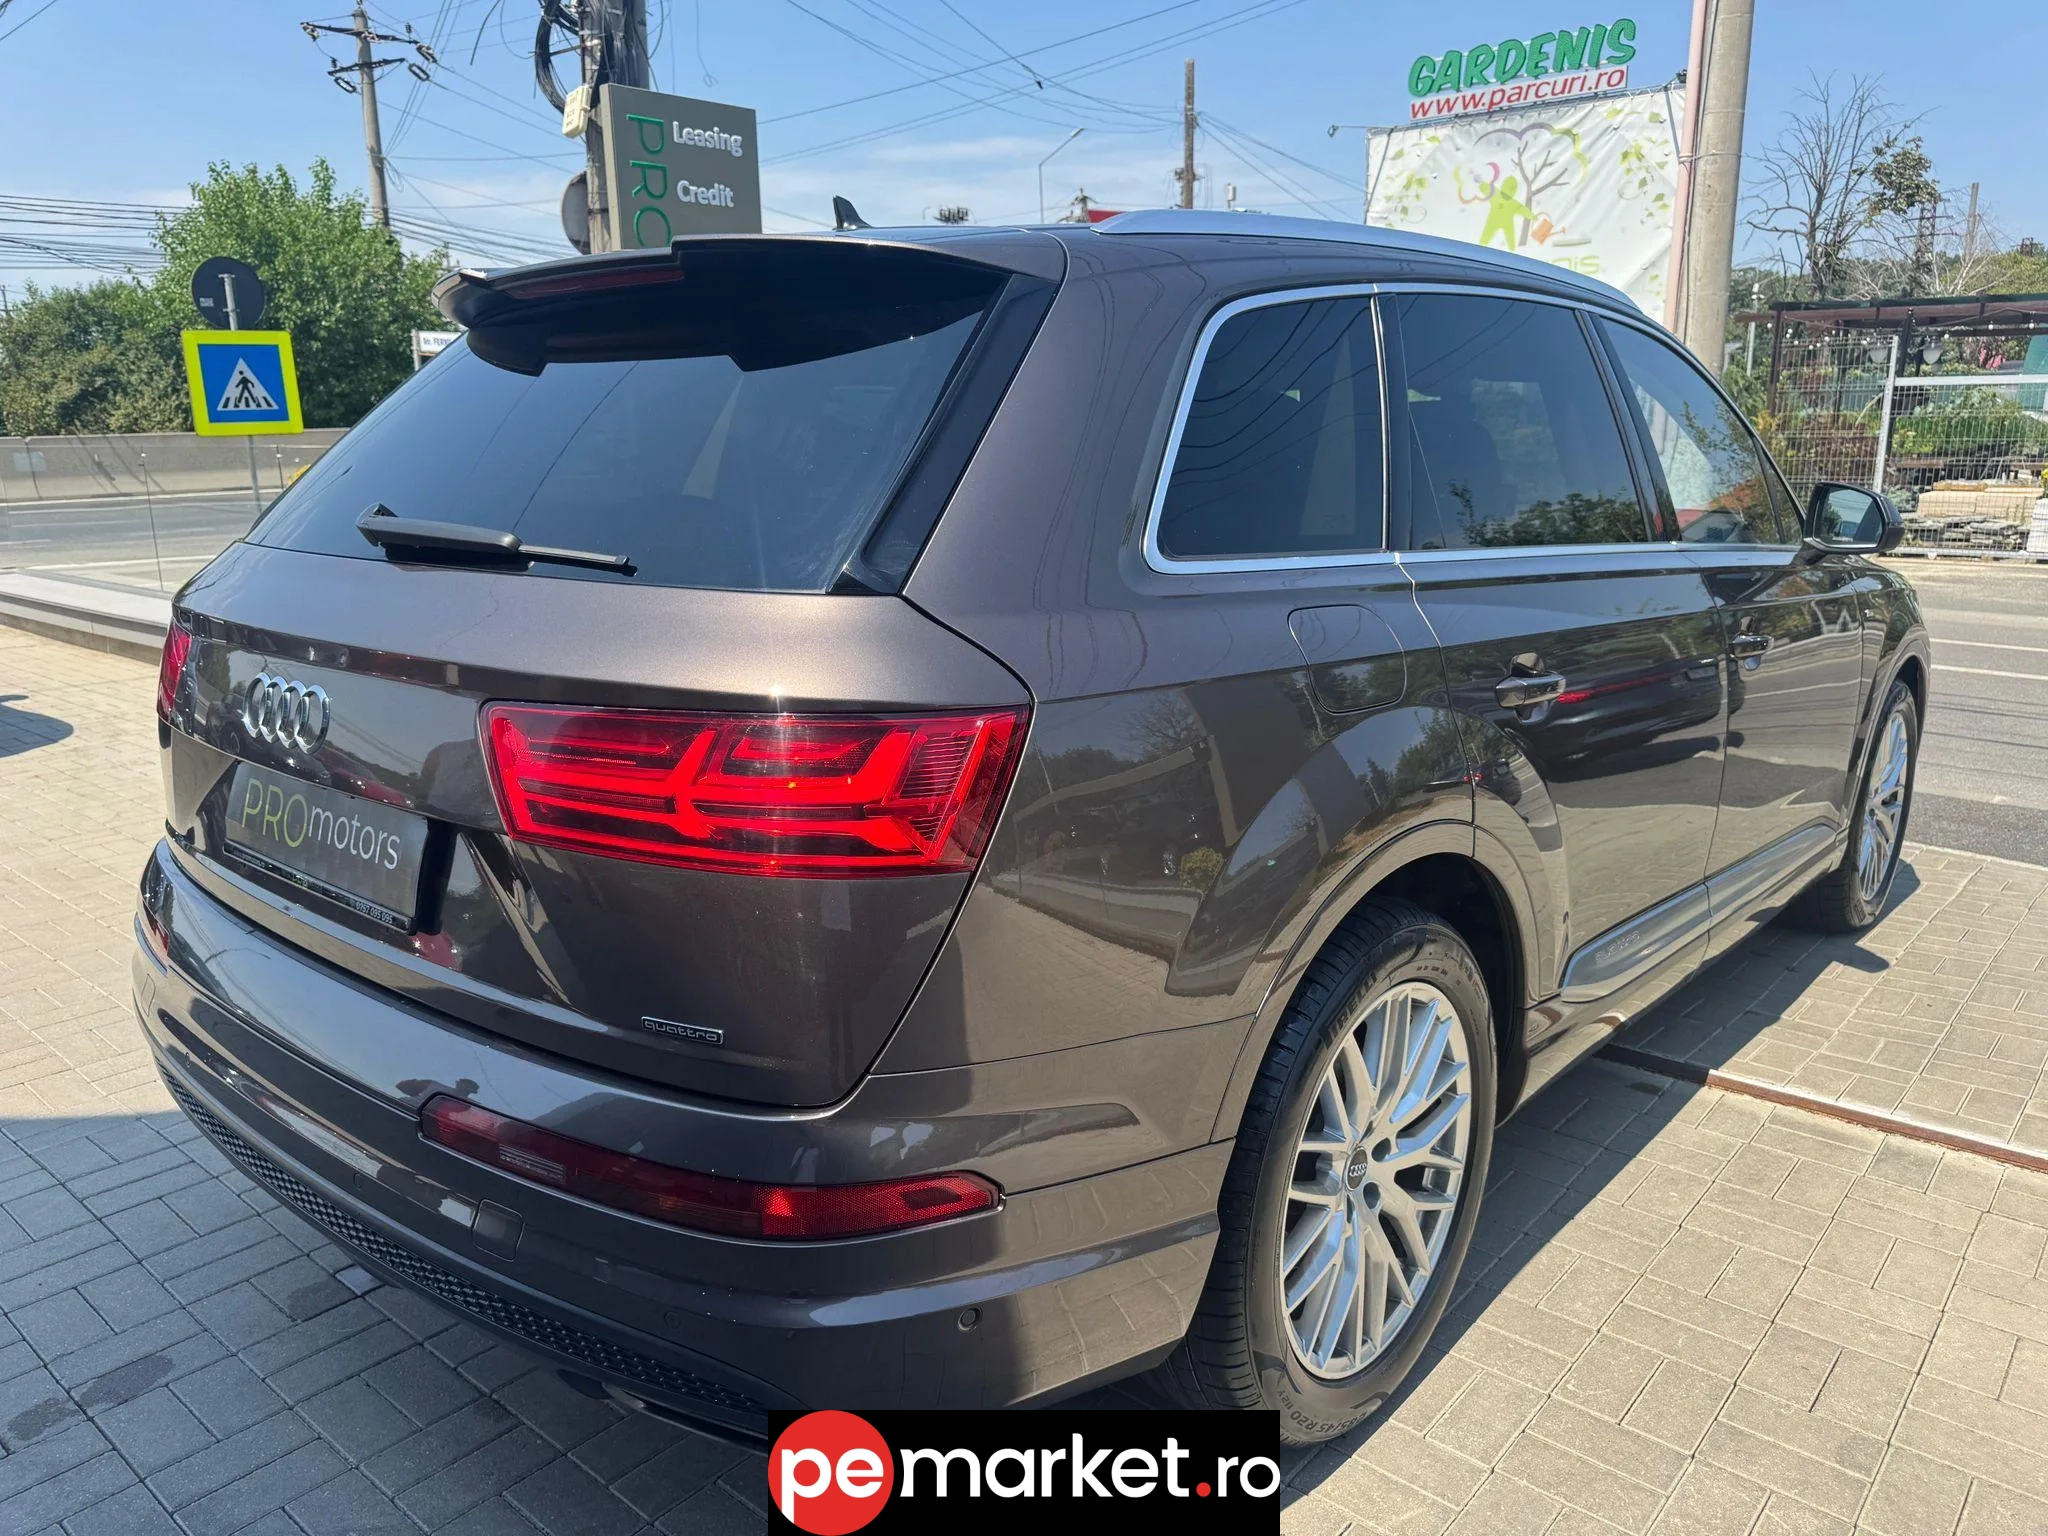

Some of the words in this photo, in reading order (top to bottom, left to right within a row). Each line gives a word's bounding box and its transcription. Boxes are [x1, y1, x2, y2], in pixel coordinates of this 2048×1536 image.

[1408, 18, 1636, 97] GARDENIS
[1411, 69, 1625, 118] www.parcuri.ro
[672, 121, 743, 157] Leasing
[676, 179, 734, 208] Credit
[644, 1020, 718, 1041] quattro
[1290, 1410, 1318, 1431] R20
